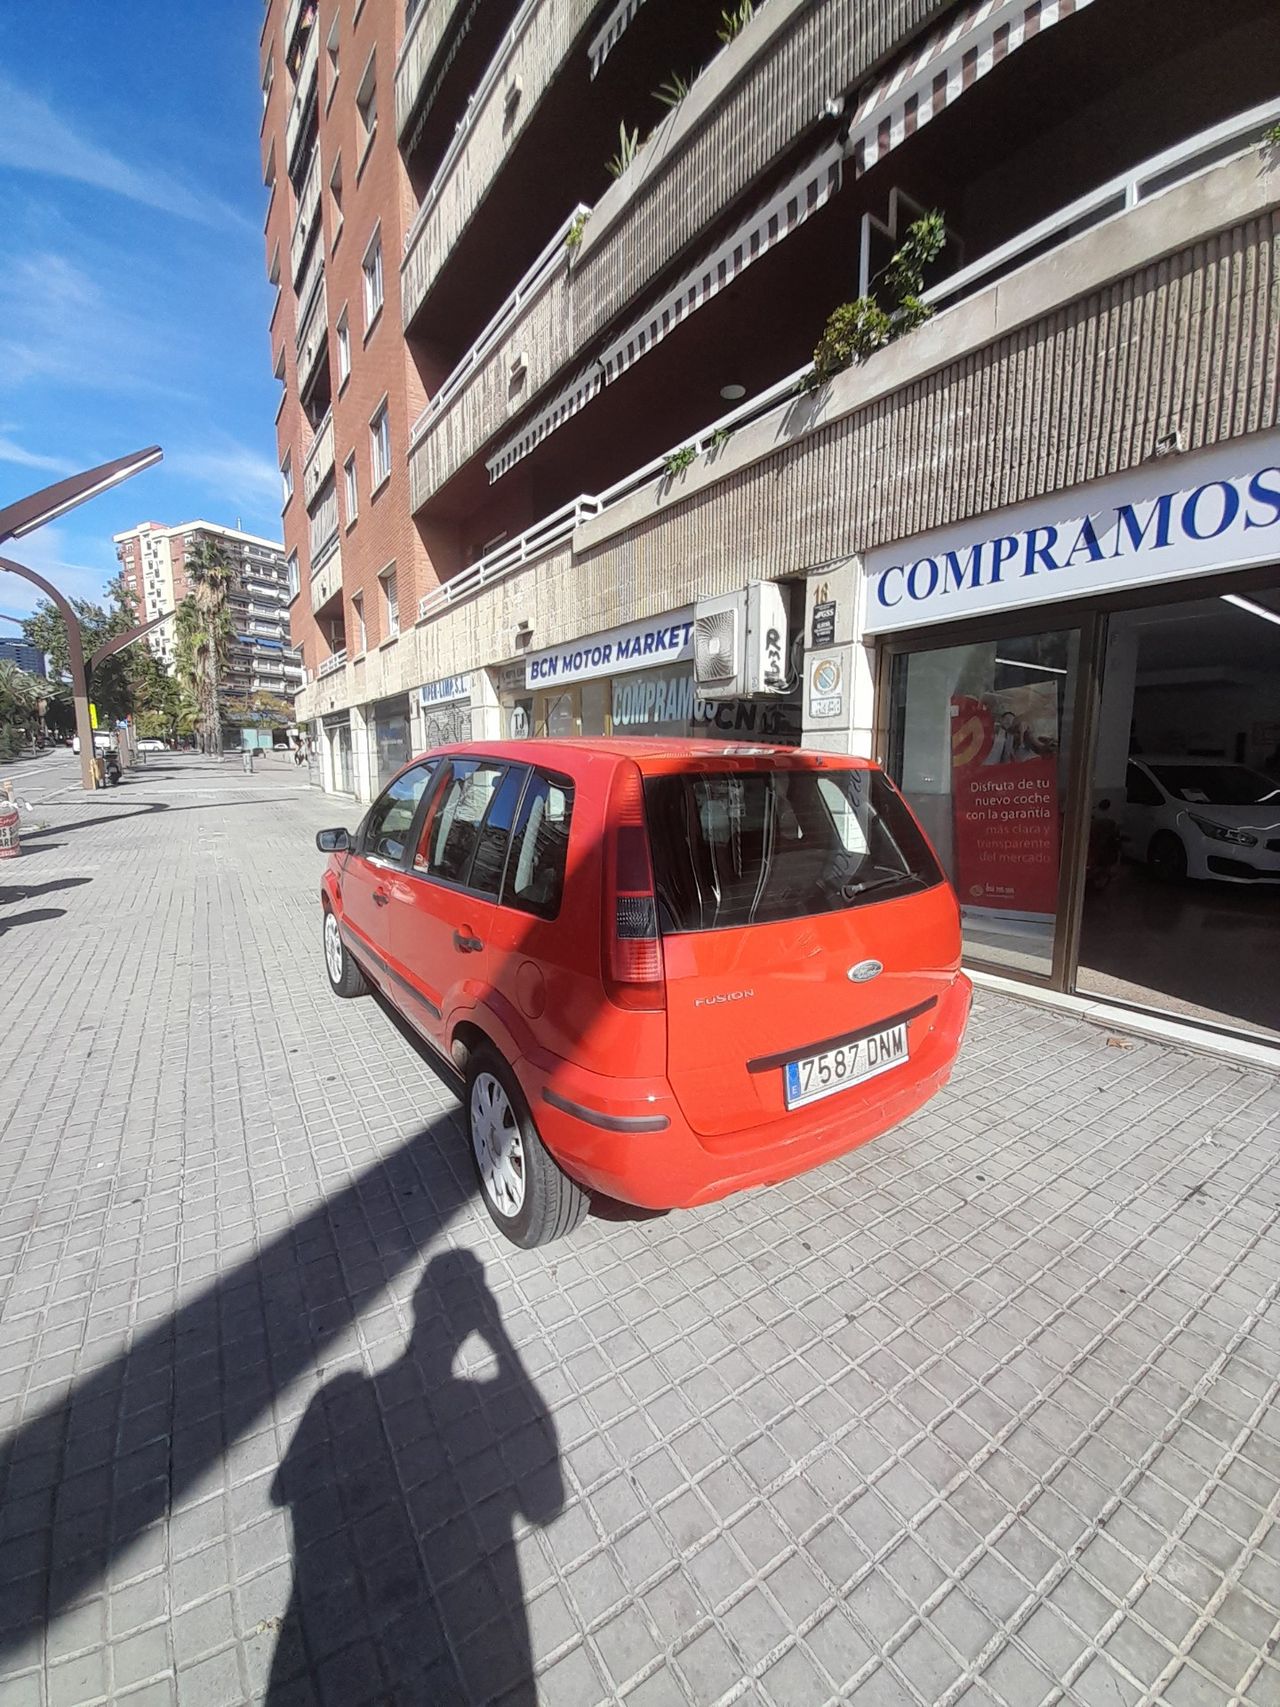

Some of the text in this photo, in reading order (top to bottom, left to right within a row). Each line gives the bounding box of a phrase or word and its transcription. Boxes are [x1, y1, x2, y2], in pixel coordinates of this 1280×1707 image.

[877, 466, 1280, 608] COMPRAMOS
[530, 654, 558, 680] BCN
[562, 645, 612, 673] MOTOR
[616, 621, 694, 660] MARKET
[970, 779, 1050, 793] Disfruta de tu
[975, 792, 1050, 806] nuevo coche
[966, 811, 985, 820] con
[988, 809, 998, 819] la
[694, 988, 754, 1008] FUSION
[801, 1043, 860, 1092] 7587
[867, 1026, 903, 1067] DNM
